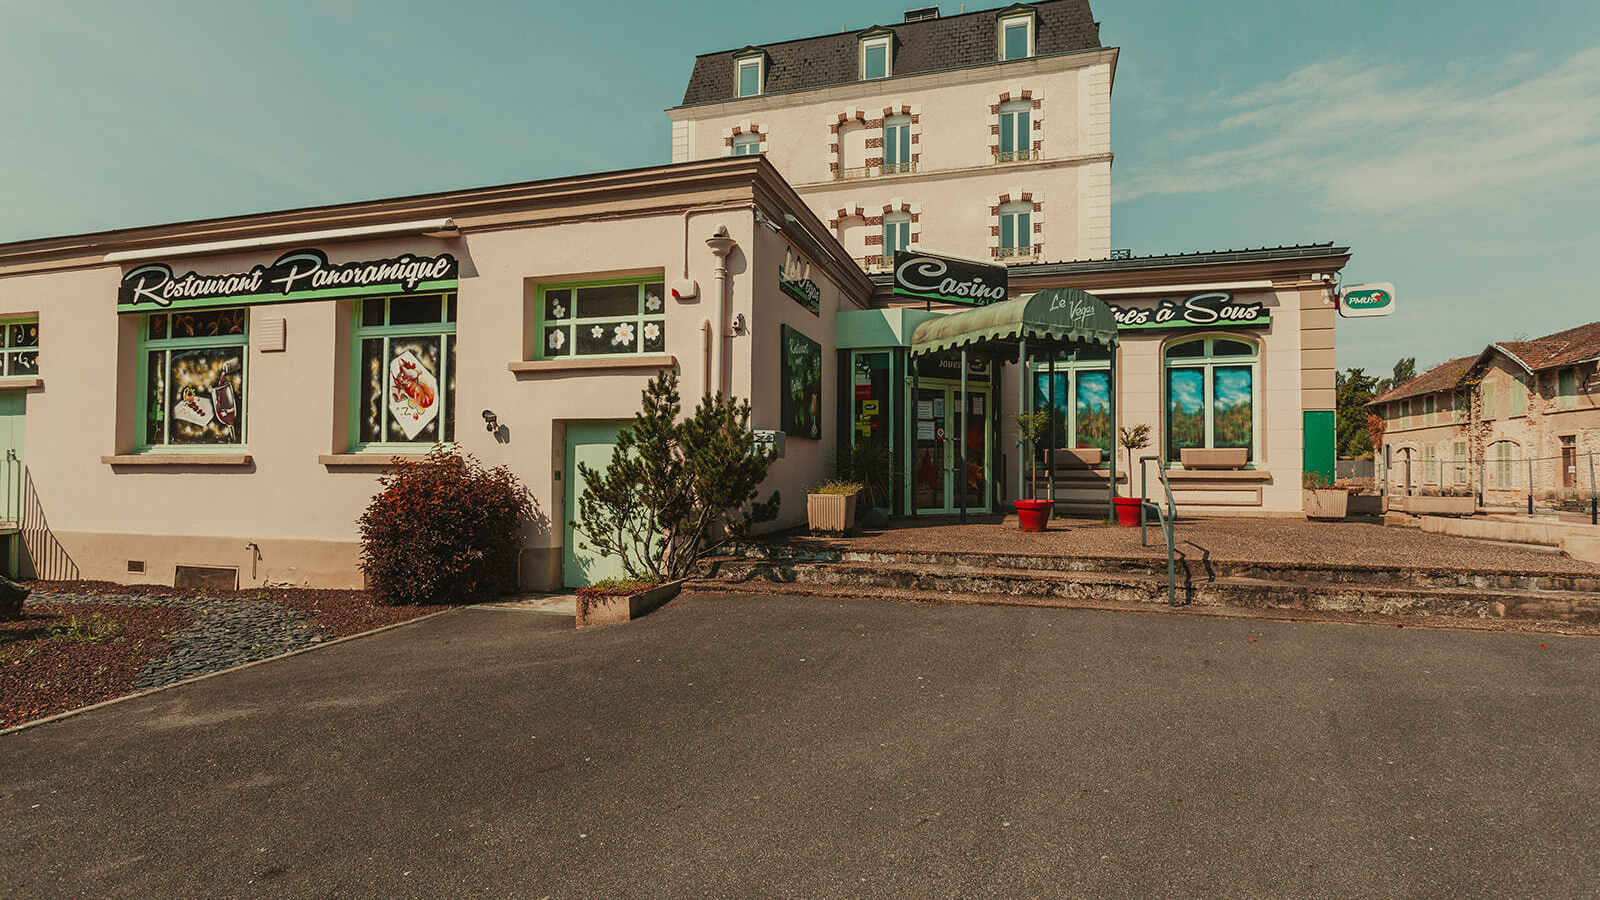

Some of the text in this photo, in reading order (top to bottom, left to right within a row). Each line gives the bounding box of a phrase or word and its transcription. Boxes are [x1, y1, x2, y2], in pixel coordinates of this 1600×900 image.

[125, 253, 451, 305] Restaurant Panoramique
[896, 257, 1005, 299] Casino
[1049, 293, 1096, 325] Le Vegas
[1155, 301, 1175, 322] à
[1183, 292, 1261, 323] Sous
[1348, 296, 1371, 305] PMU
